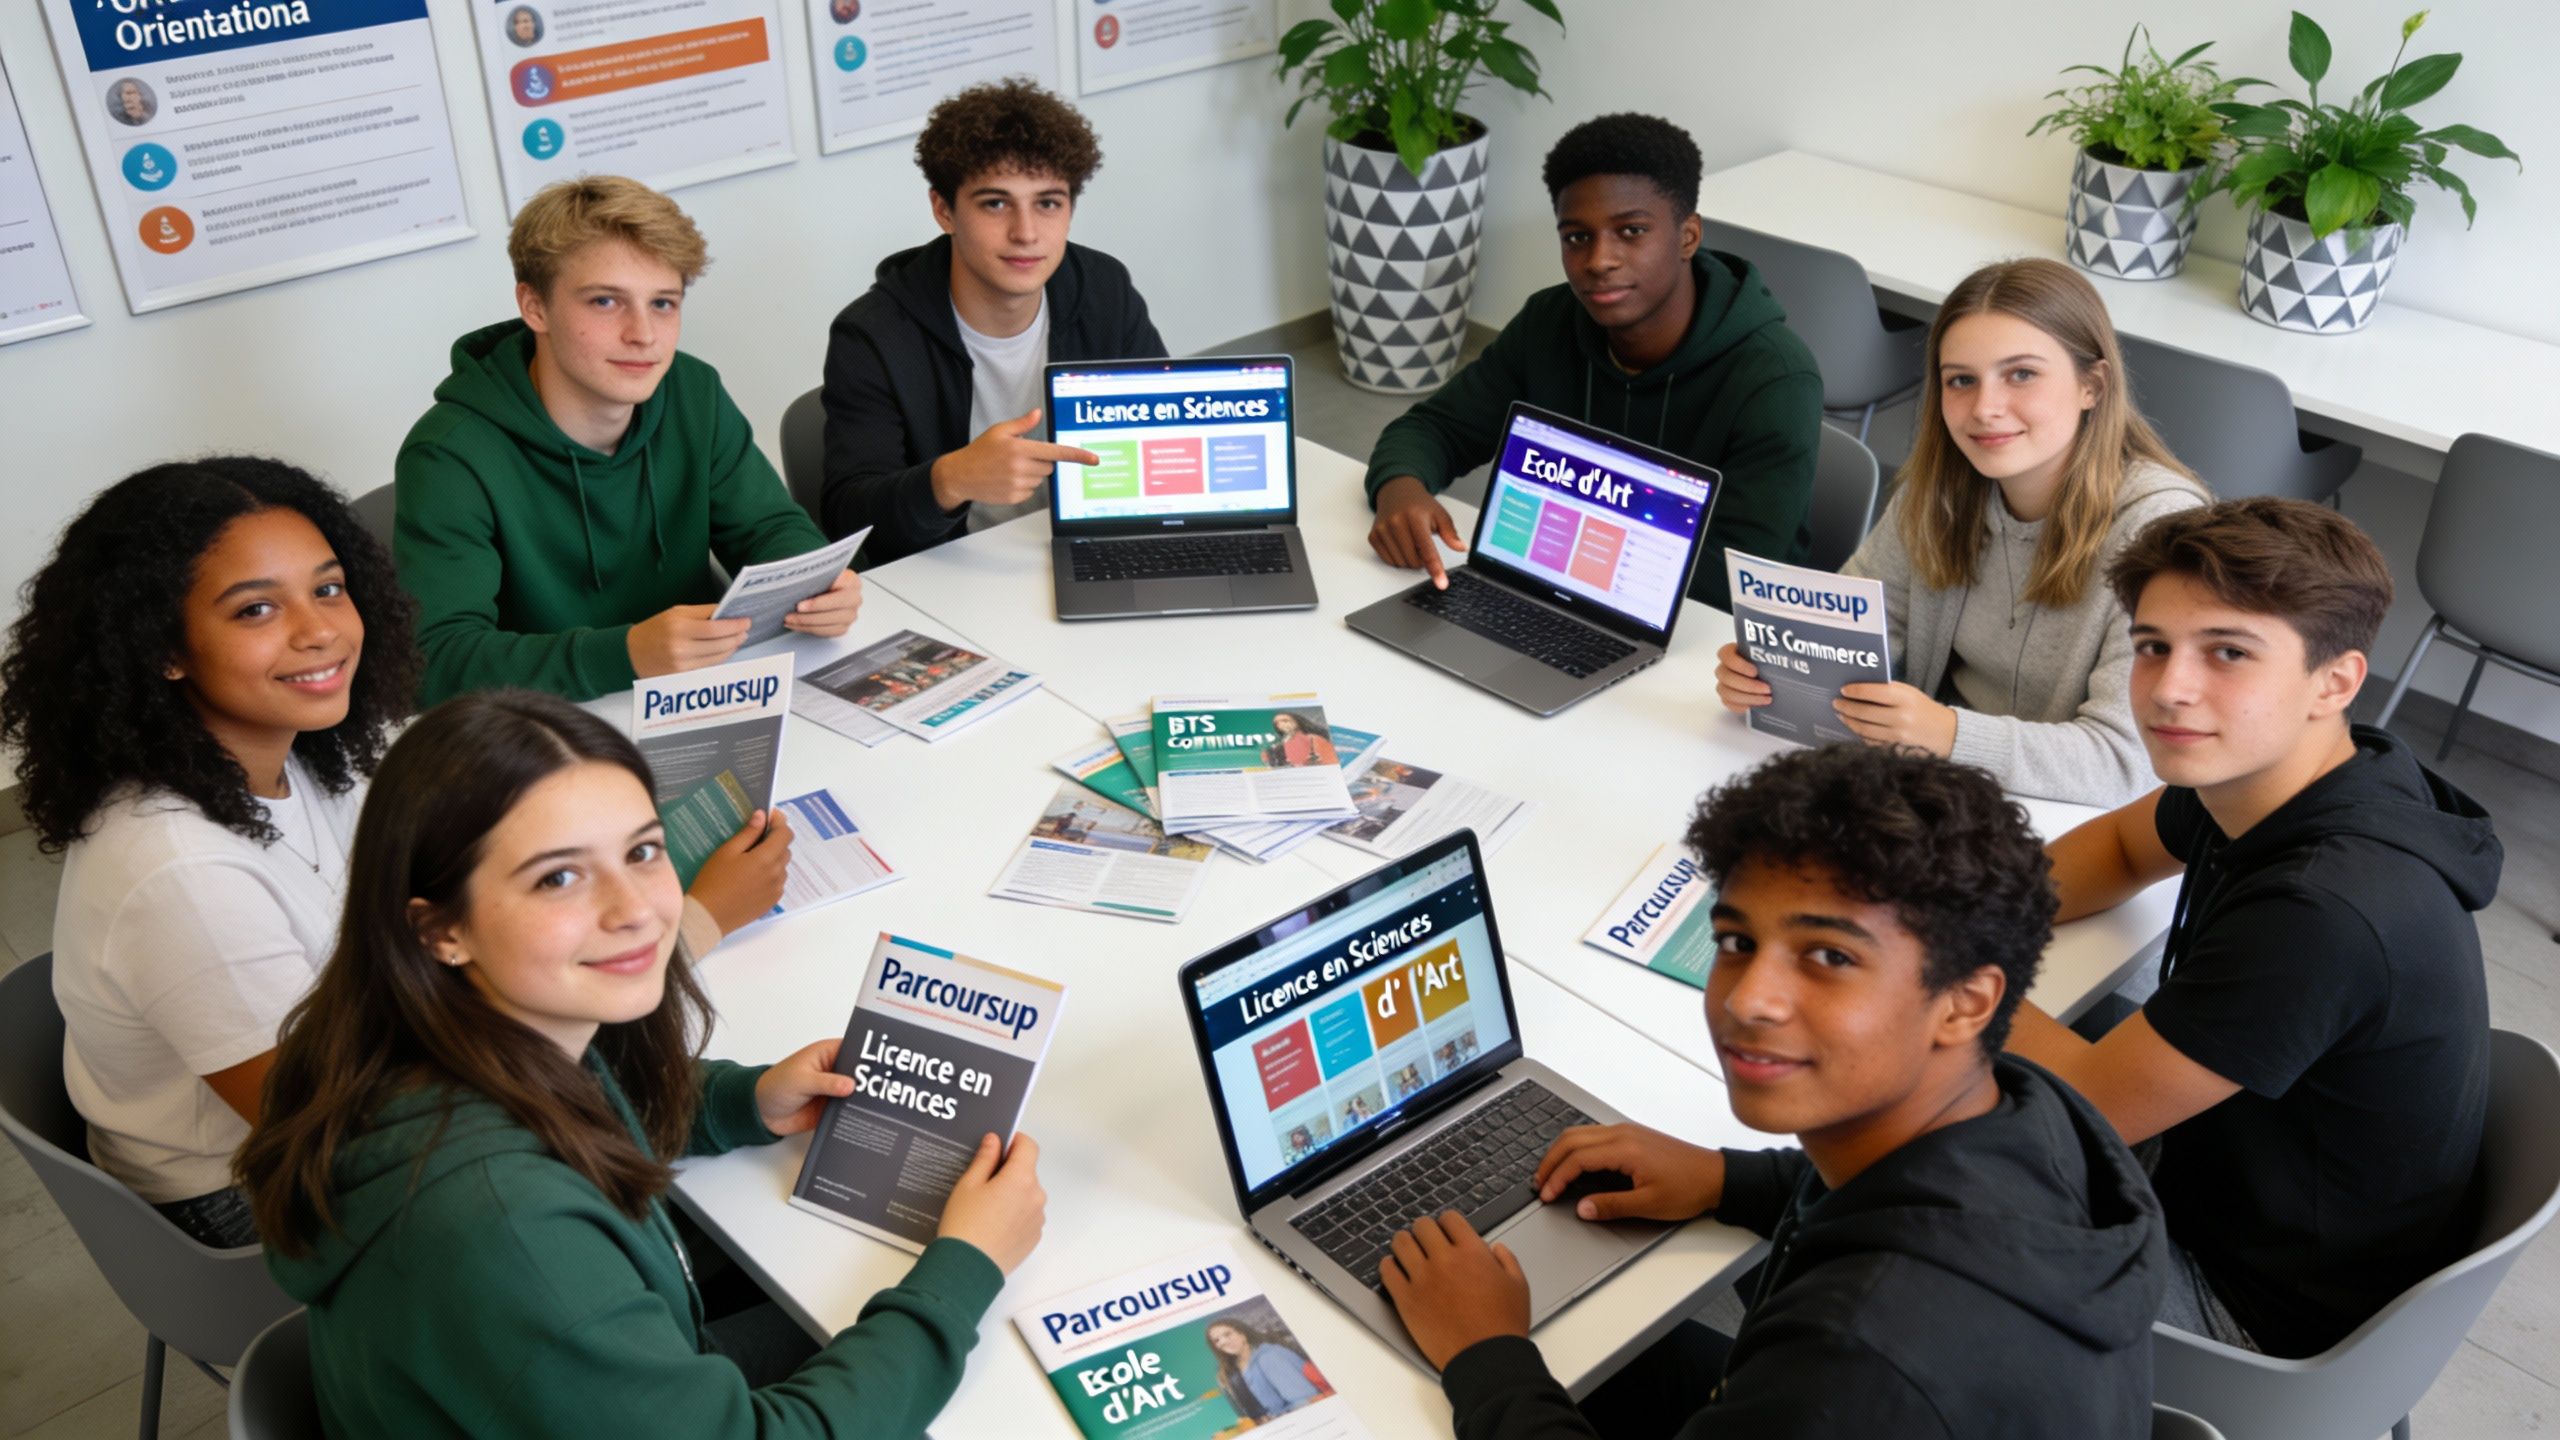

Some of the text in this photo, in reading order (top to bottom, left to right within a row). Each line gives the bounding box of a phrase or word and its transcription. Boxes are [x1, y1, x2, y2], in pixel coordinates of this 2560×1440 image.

[115, 0, 311, 51] Orientationa
[1074, 395, 1270, 424] Licence en Sciences
[1521, 447, 1634, 508] Ecole d'Art
[1738, 569, 1869, 622] Parcoursup
[1744, 618, 1778, 647] BTS
[644, 675, 779, 720] Parcoursup
[1168, 714, 1216, 736] BTS
[1239, 912, 1433, 1025] Licence en Sciences
[878, 956, 1039, 1041] Parcoursup
[860, 1028, 993, 1097] Licence en
[854, 1064, 959, 1120] Sciences
[1041, 1263, 1232, 1345] Parcoursup
[1077, 1349, 1161, 1397] Ecole
[1102, 1373, 1186, 1425] d'Art
